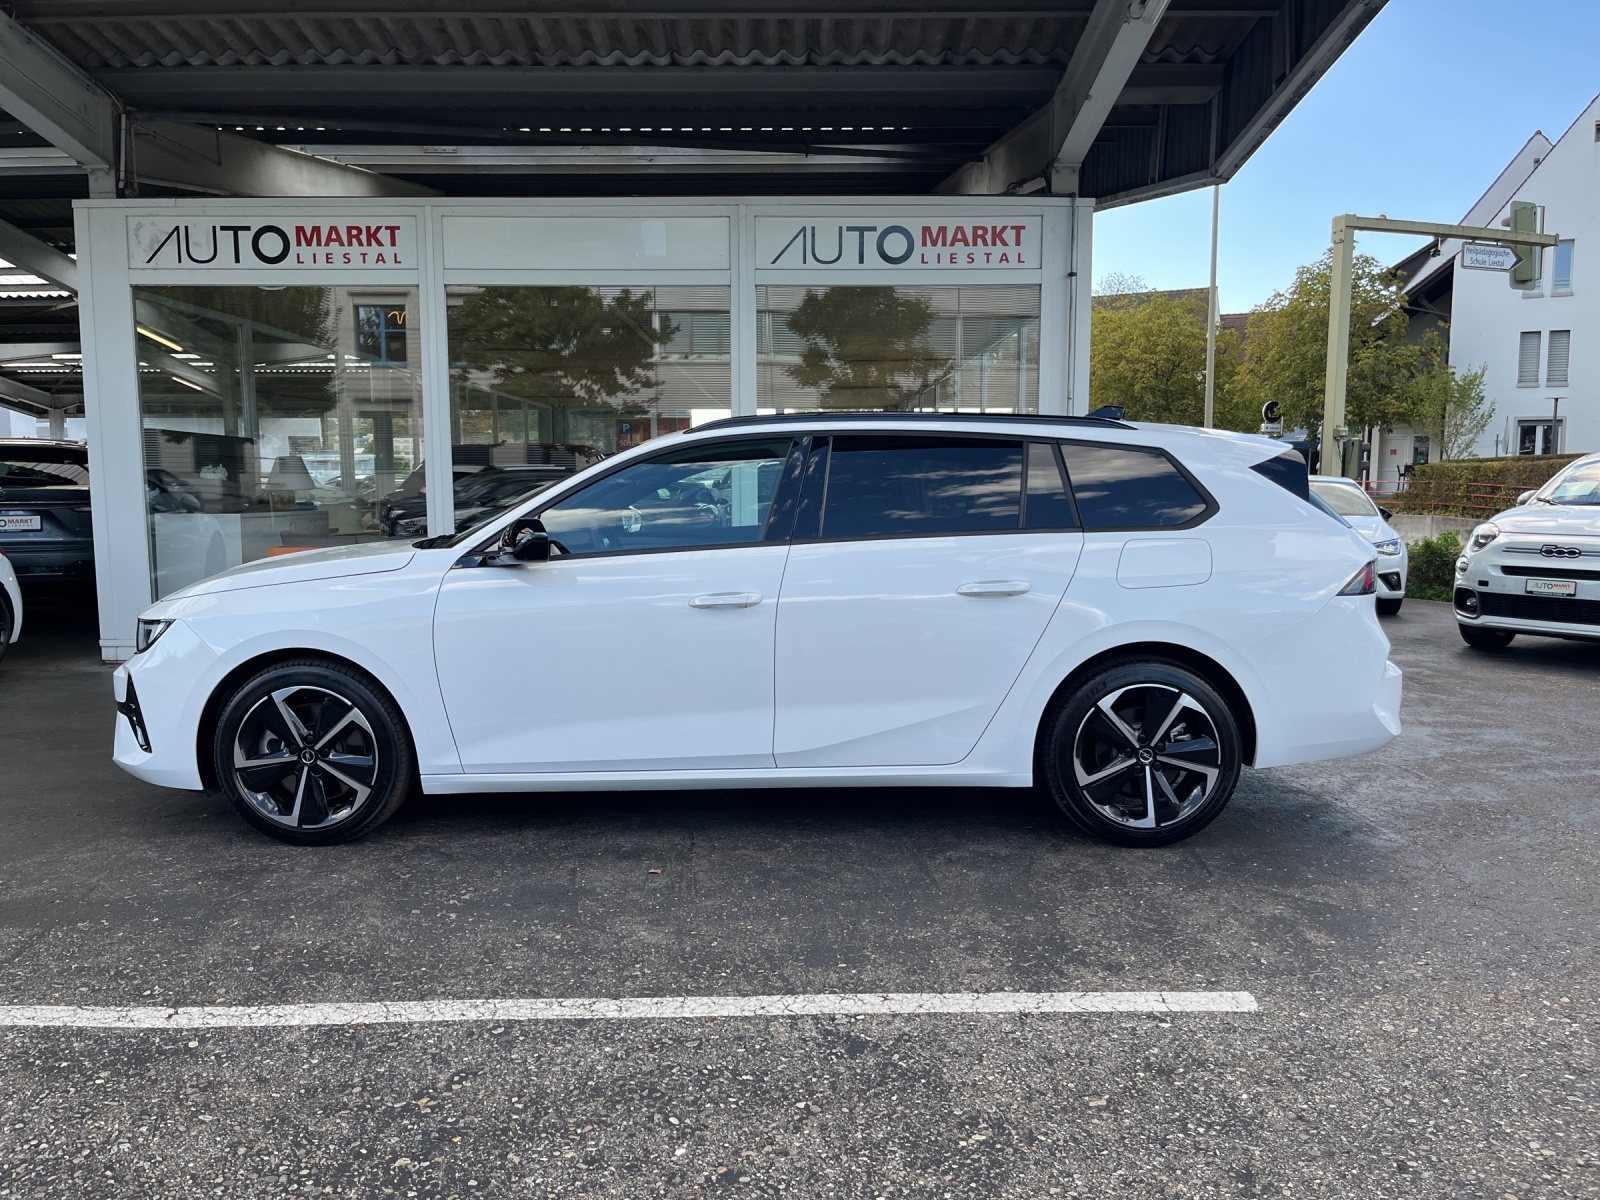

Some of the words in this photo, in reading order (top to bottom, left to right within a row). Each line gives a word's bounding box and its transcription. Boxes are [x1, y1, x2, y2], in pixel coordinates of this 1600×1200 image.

[146, 225, 291, 265] AUTO
[295, 225, 401, 247] MARKT
[770, 225, 915, 265] AUTO
[921, 225, 1026, 247] MARKT
[296, 252, 402, 264] LIESTAL
[921, 252, 1026, 264] LIESTAL
[1465, 246, 1510, 258] Heilpädagogische
[1469, 257, 1487, 266] Schule
[1488, 258, 1505, 267] Liestal
[1540, 544, 1581, 559] 500
